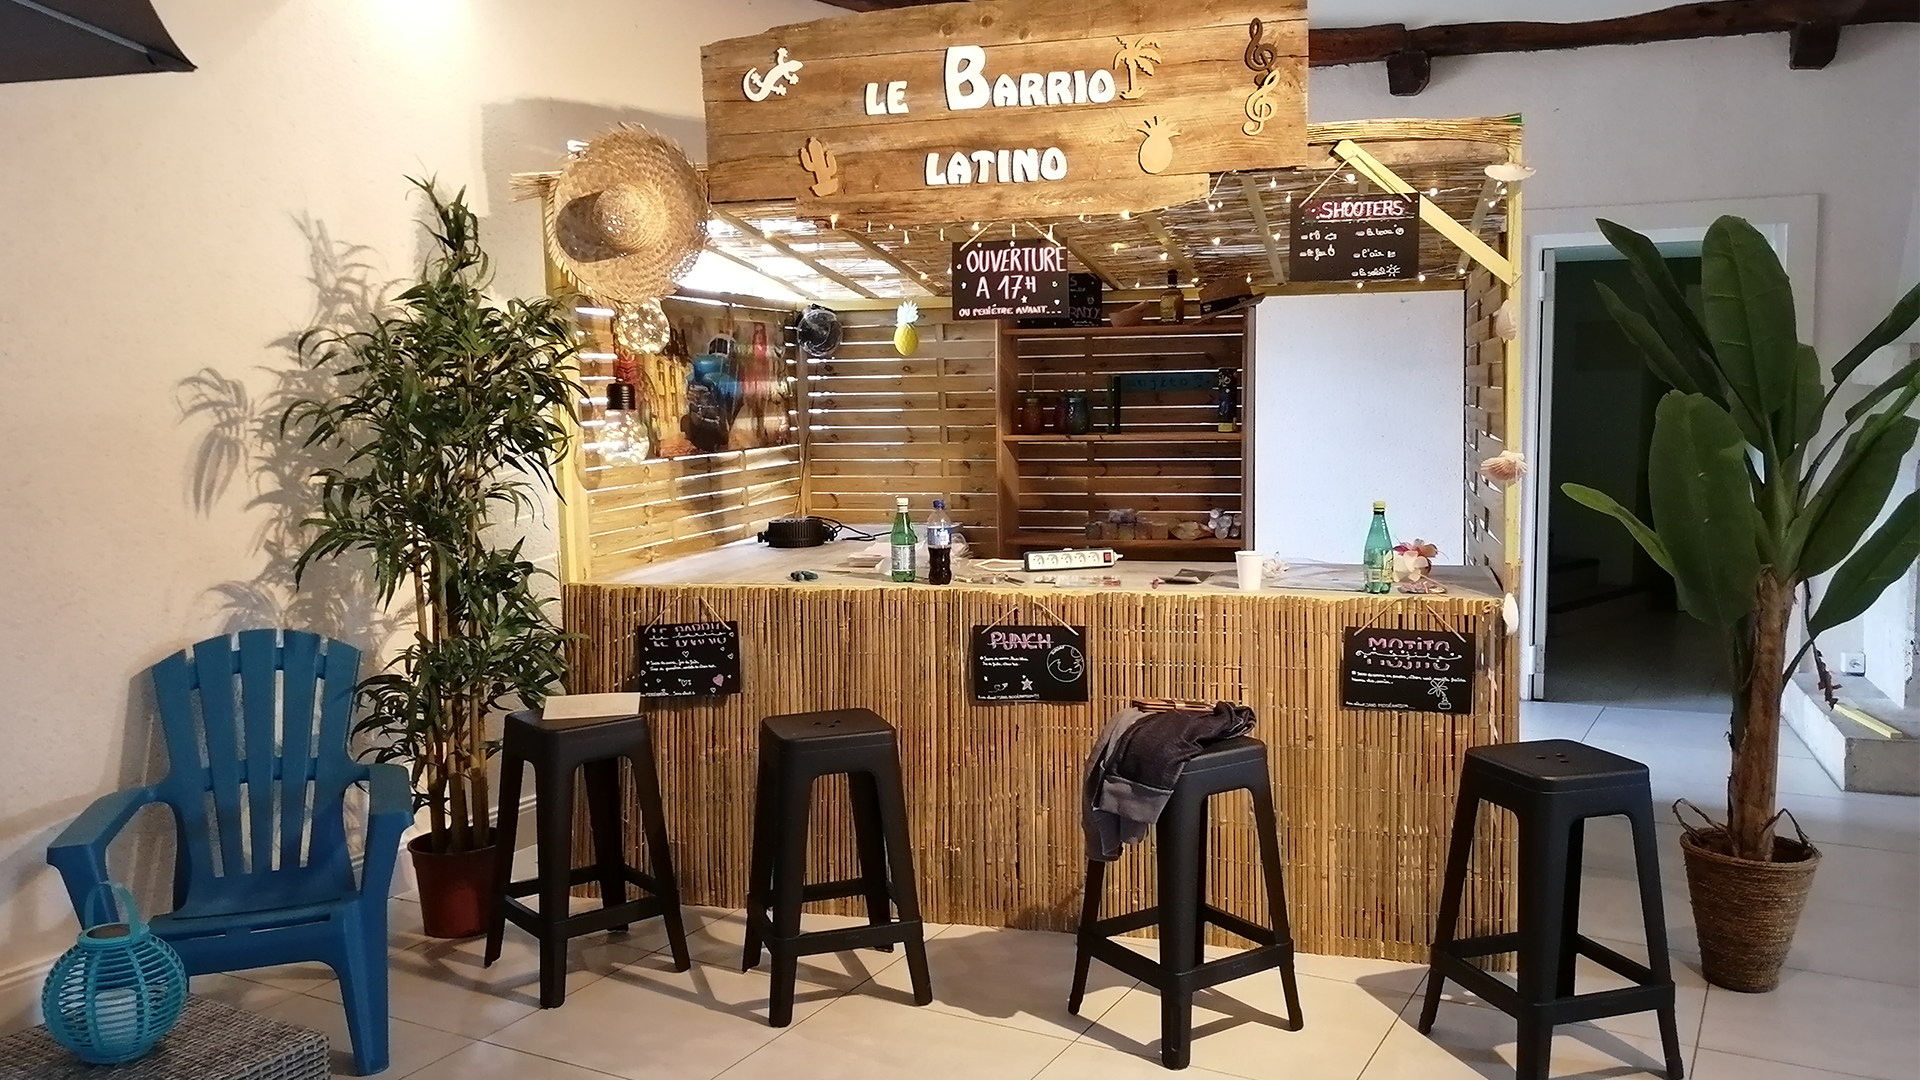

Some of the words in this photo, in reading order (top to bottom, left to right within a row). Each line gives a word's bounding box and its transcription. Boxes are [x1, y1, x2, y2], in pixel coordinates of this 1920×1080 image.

[865, 80, 909, 116] LE
[925, 146, 1068, 186] LATINO
[1320, 200, 1404, 219] SHOOTERS
[966, 246, 1067, 272] OUVERTURE
[976, 276, 990, 299] A
[997, 275, 1037, 300] 17H
[959, 308, 970, 317] OU
[989, 631, 1052, 650] PUNCH
